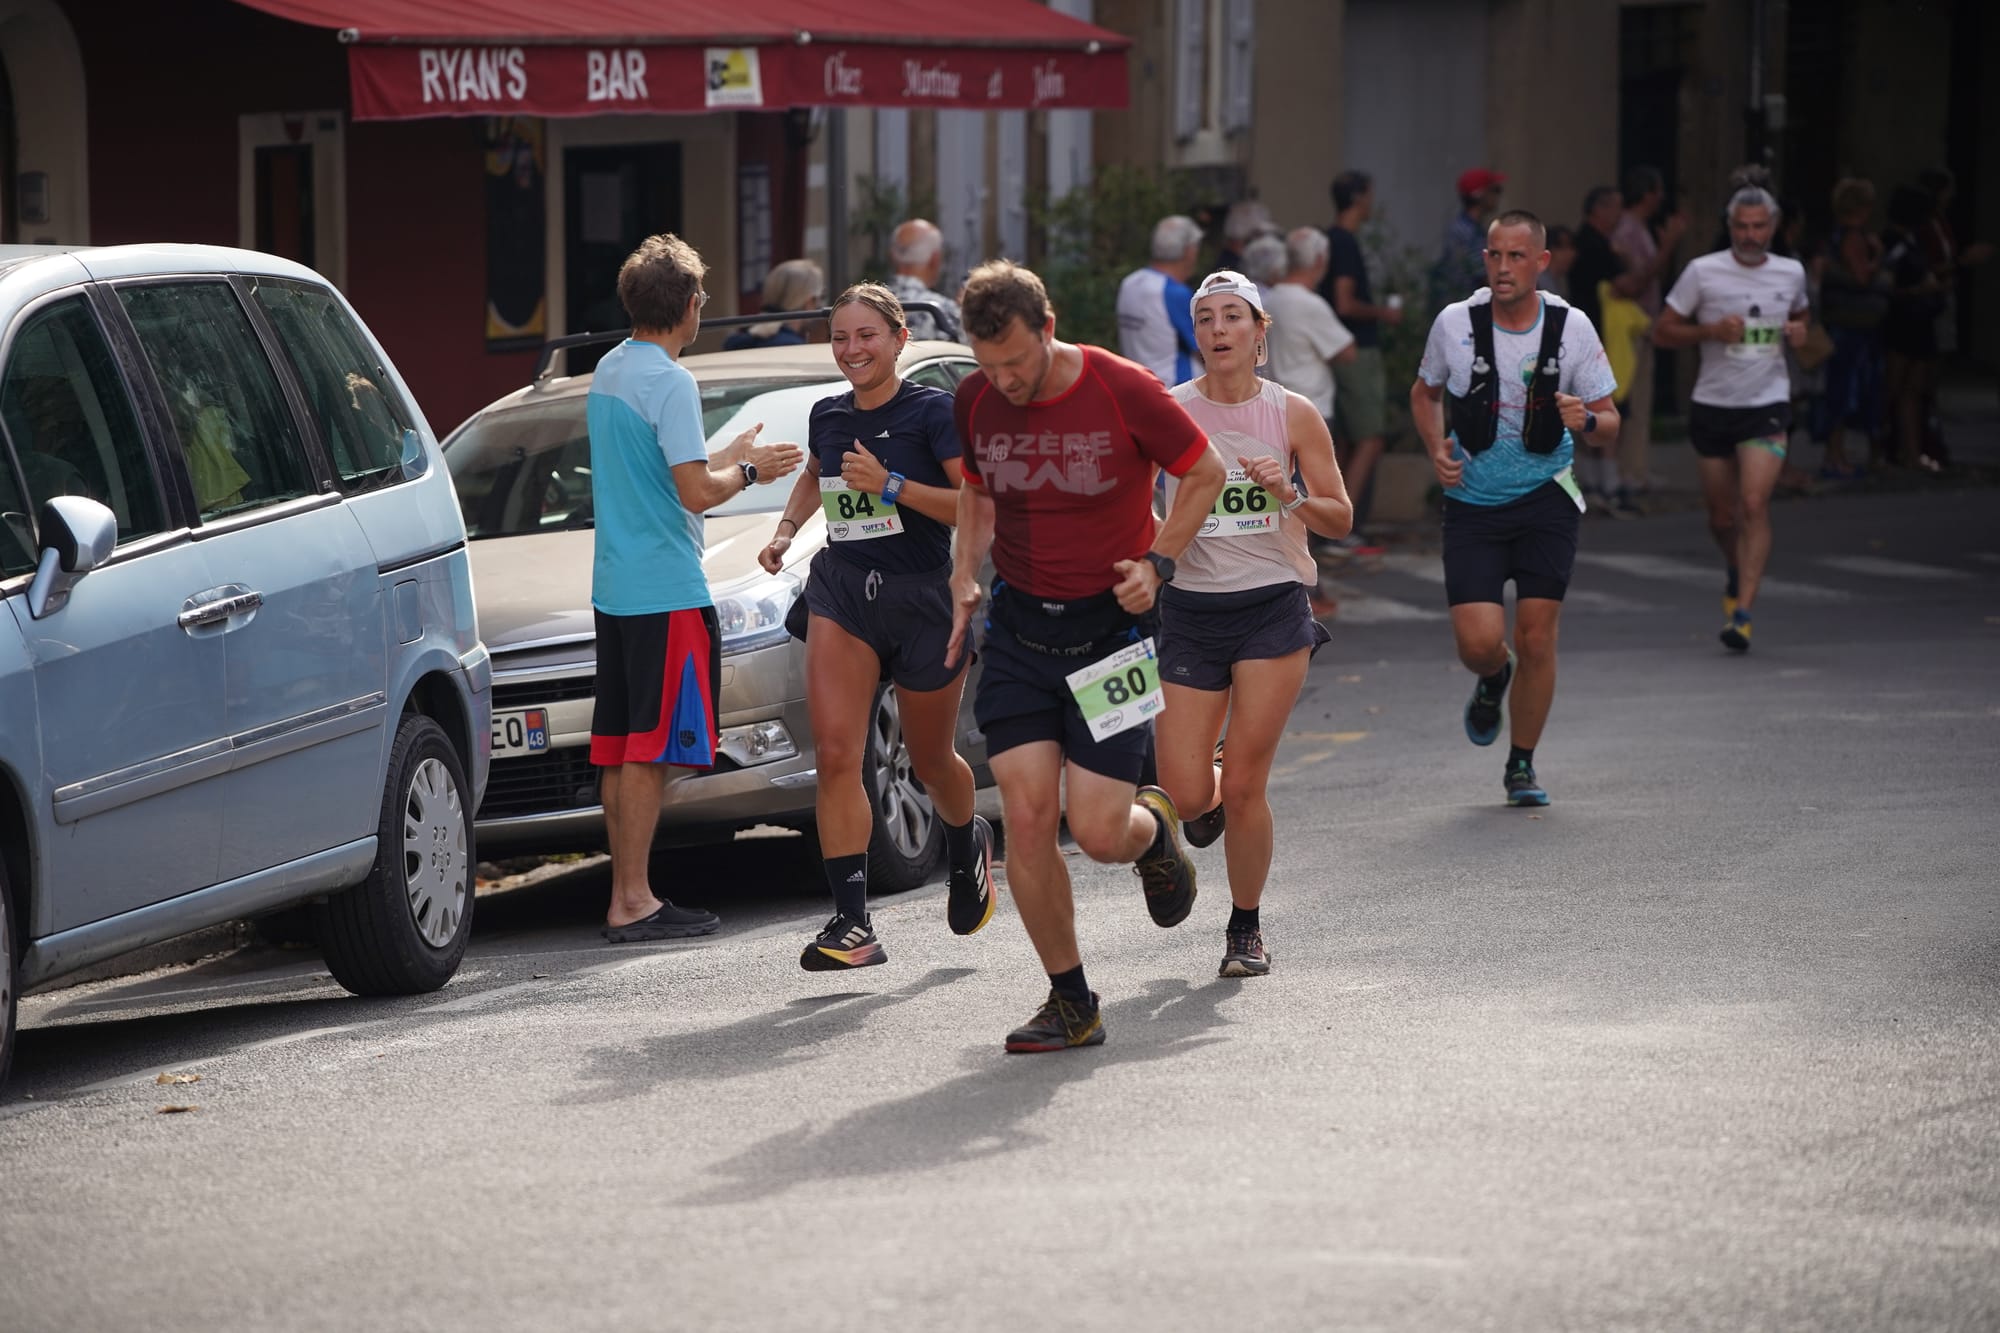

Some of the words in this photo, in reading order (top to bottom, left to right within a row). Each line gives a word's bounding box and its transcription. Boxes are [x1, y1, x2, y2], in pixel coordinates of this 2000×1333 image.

[420, 48, 527, 102] RYAN'S
[588, 49, 648, 101] BAR
[975, 430, 1113, 456] LOZÈRE
[837, 492, 875, 520] 84
[1210, 485, 1267, 514] 66
[1103, 666, 1146, 705] 80
[529, 731, 545, 747] 48
